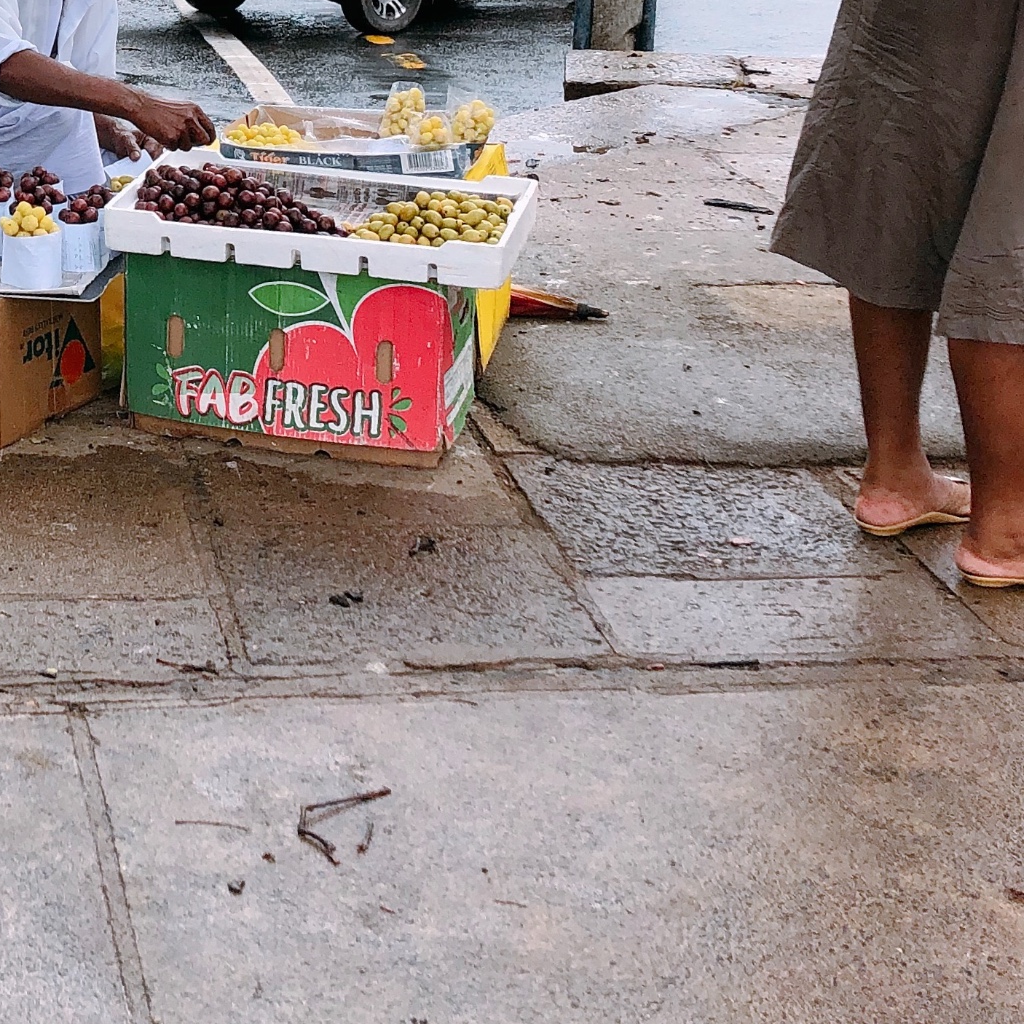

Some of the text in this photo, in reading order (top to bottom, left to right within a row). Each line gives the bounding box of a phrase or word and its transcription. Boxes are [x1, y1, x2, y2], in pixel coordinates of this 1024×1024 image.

[298, 155, 342, 166] BLACK
[172, 365, 382, 438] FAB FRESH
